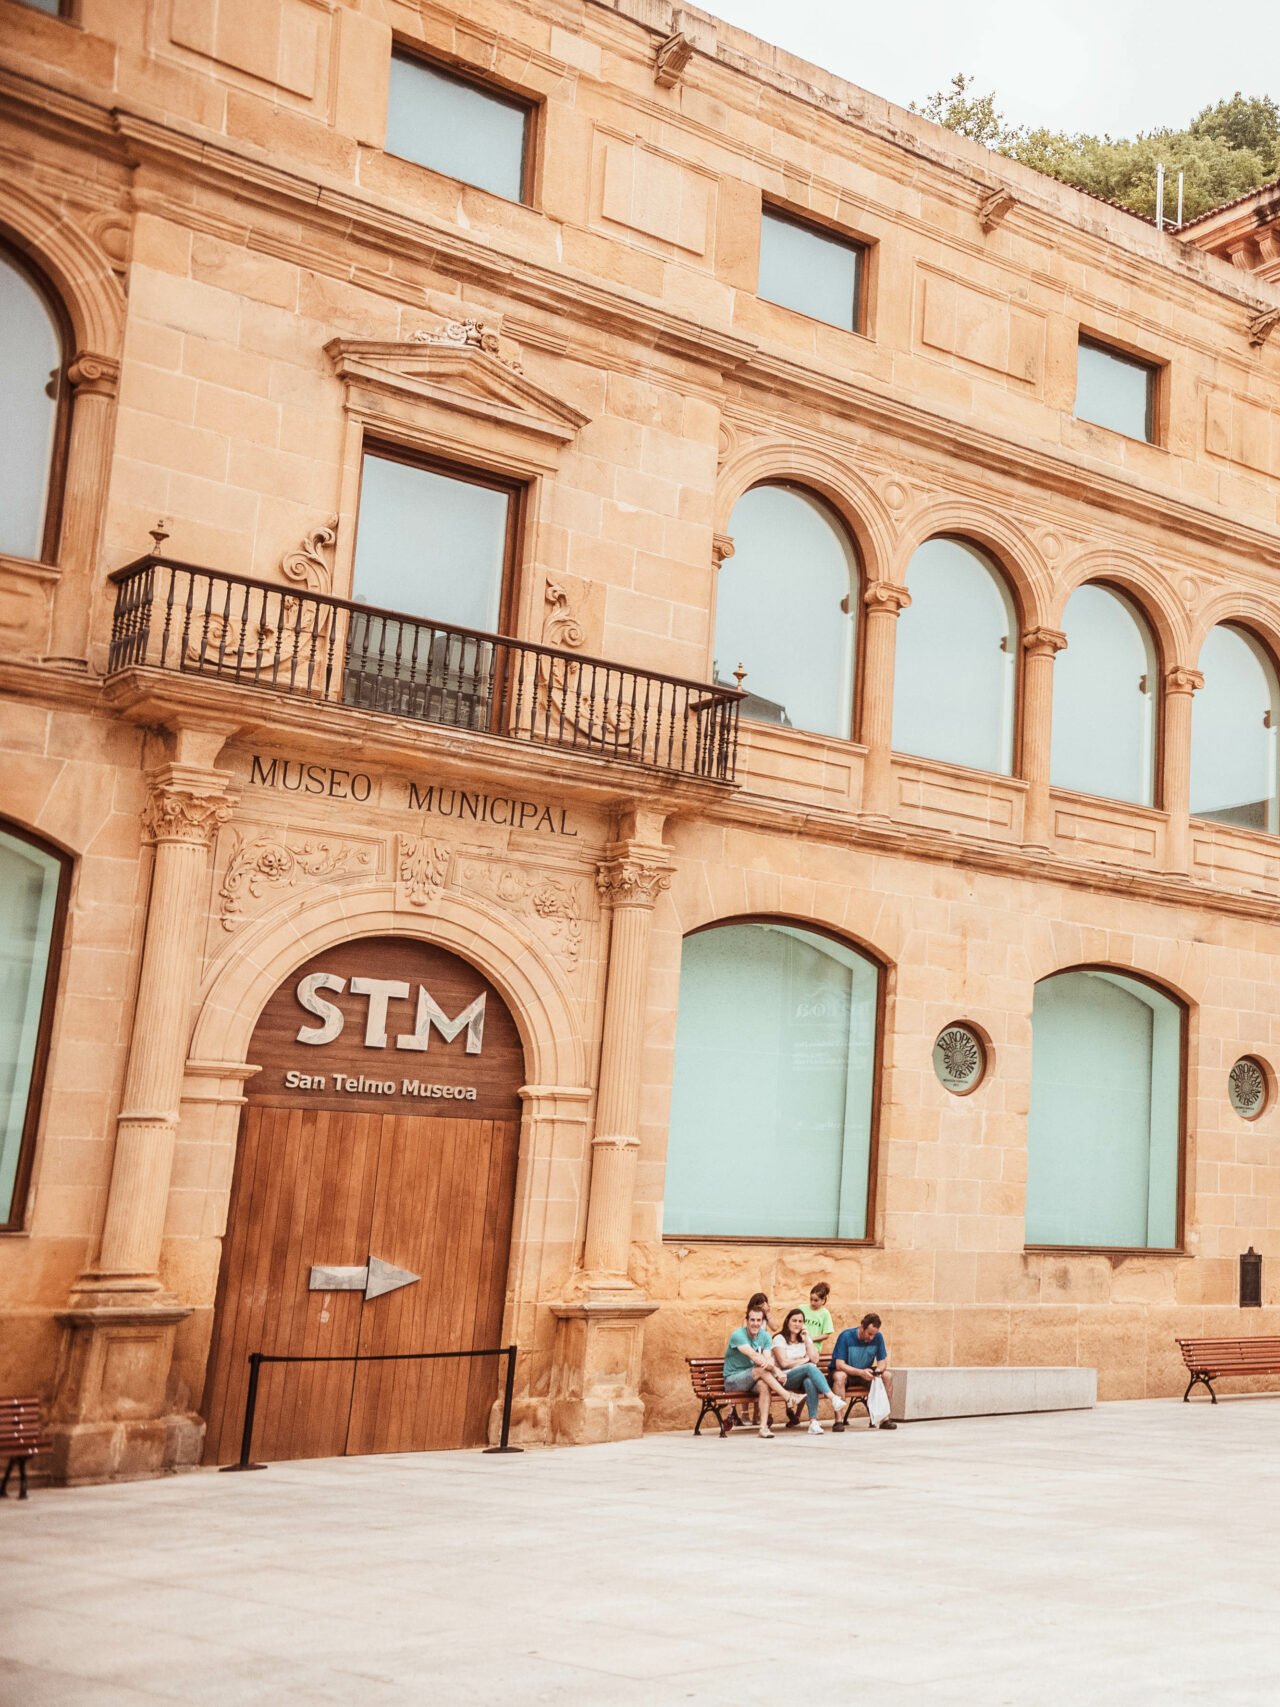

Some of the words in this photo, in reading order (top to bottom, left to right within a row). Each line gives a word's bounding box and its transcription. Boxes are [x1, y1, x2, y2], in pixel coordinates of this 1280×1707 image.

[249, 755, 372, 802] MUSEO
[407, 782, 577, 837] MUNICIPAL
[296, 972, 487, 1054] STM
[285, 1070, 326, 1090] San
[332, 1073, 396, 1095] Telmo
[402, 1079, 477, 1101] Museoa
